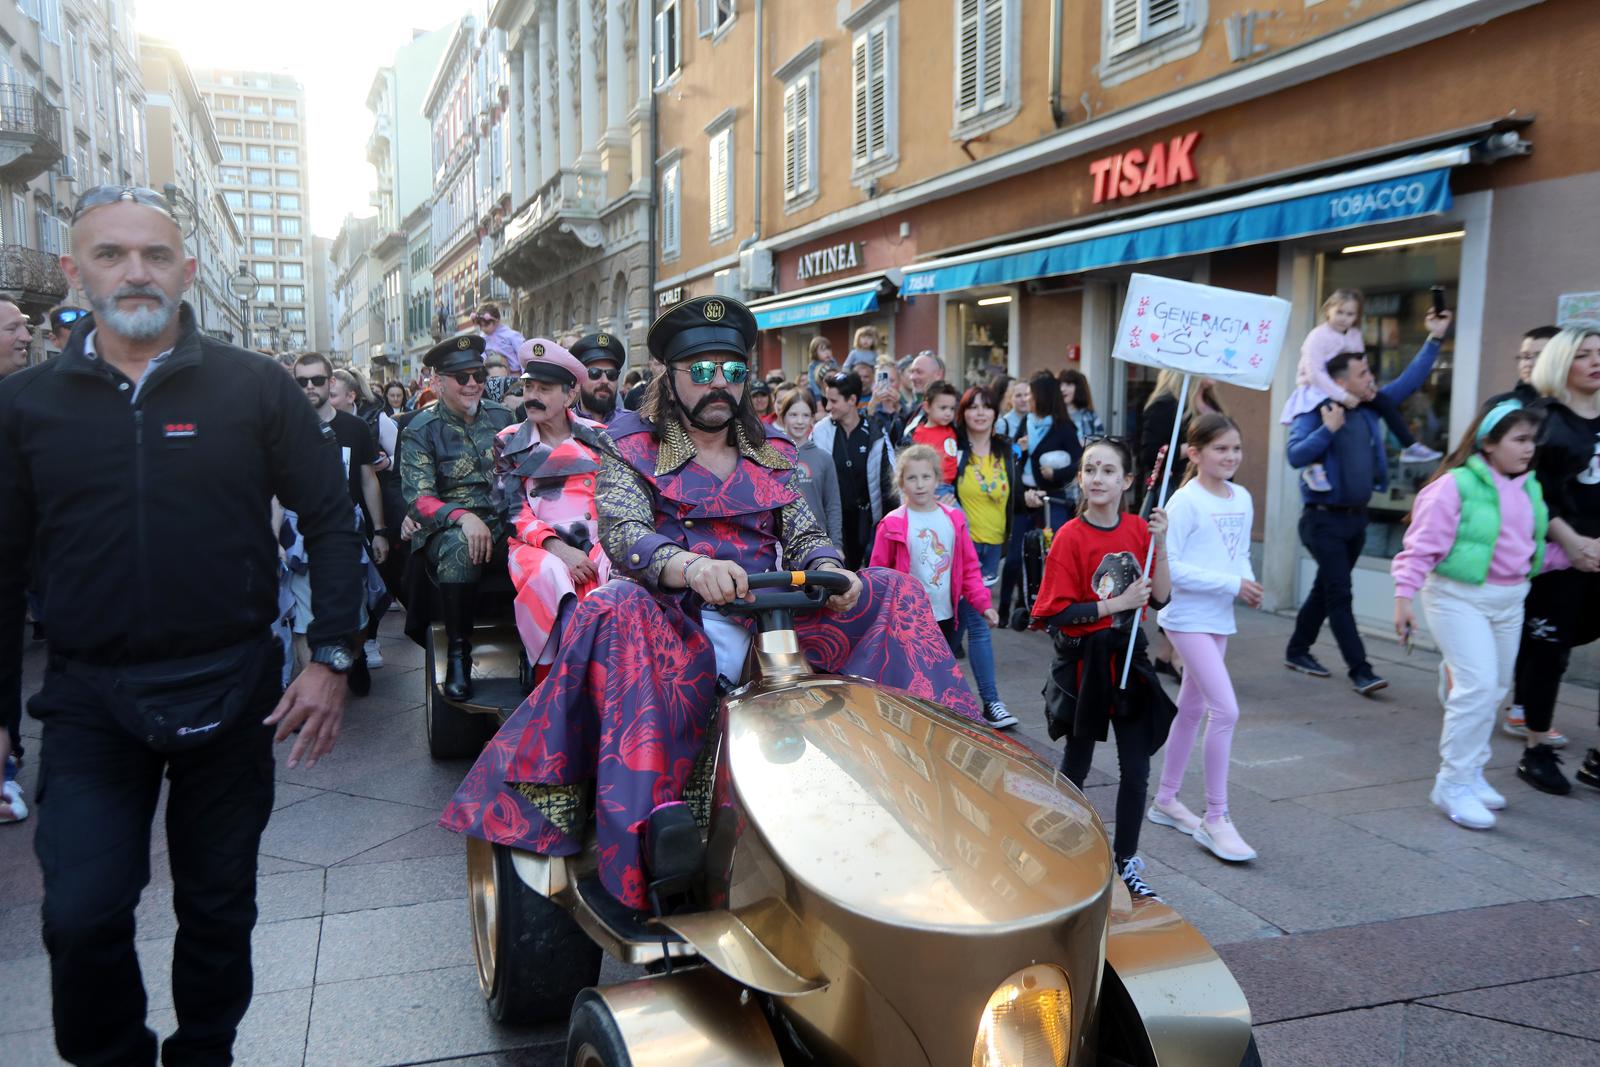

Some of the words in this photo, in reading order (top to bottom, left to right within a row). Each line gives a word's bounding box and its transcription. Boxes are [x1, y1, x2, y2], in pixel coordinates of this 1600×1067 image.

[1089, 131, 1199, 204] TISAK
[1329, 182, 1424, 218] TOBACCO
[796, 241, 858, 280] ANTINEA
